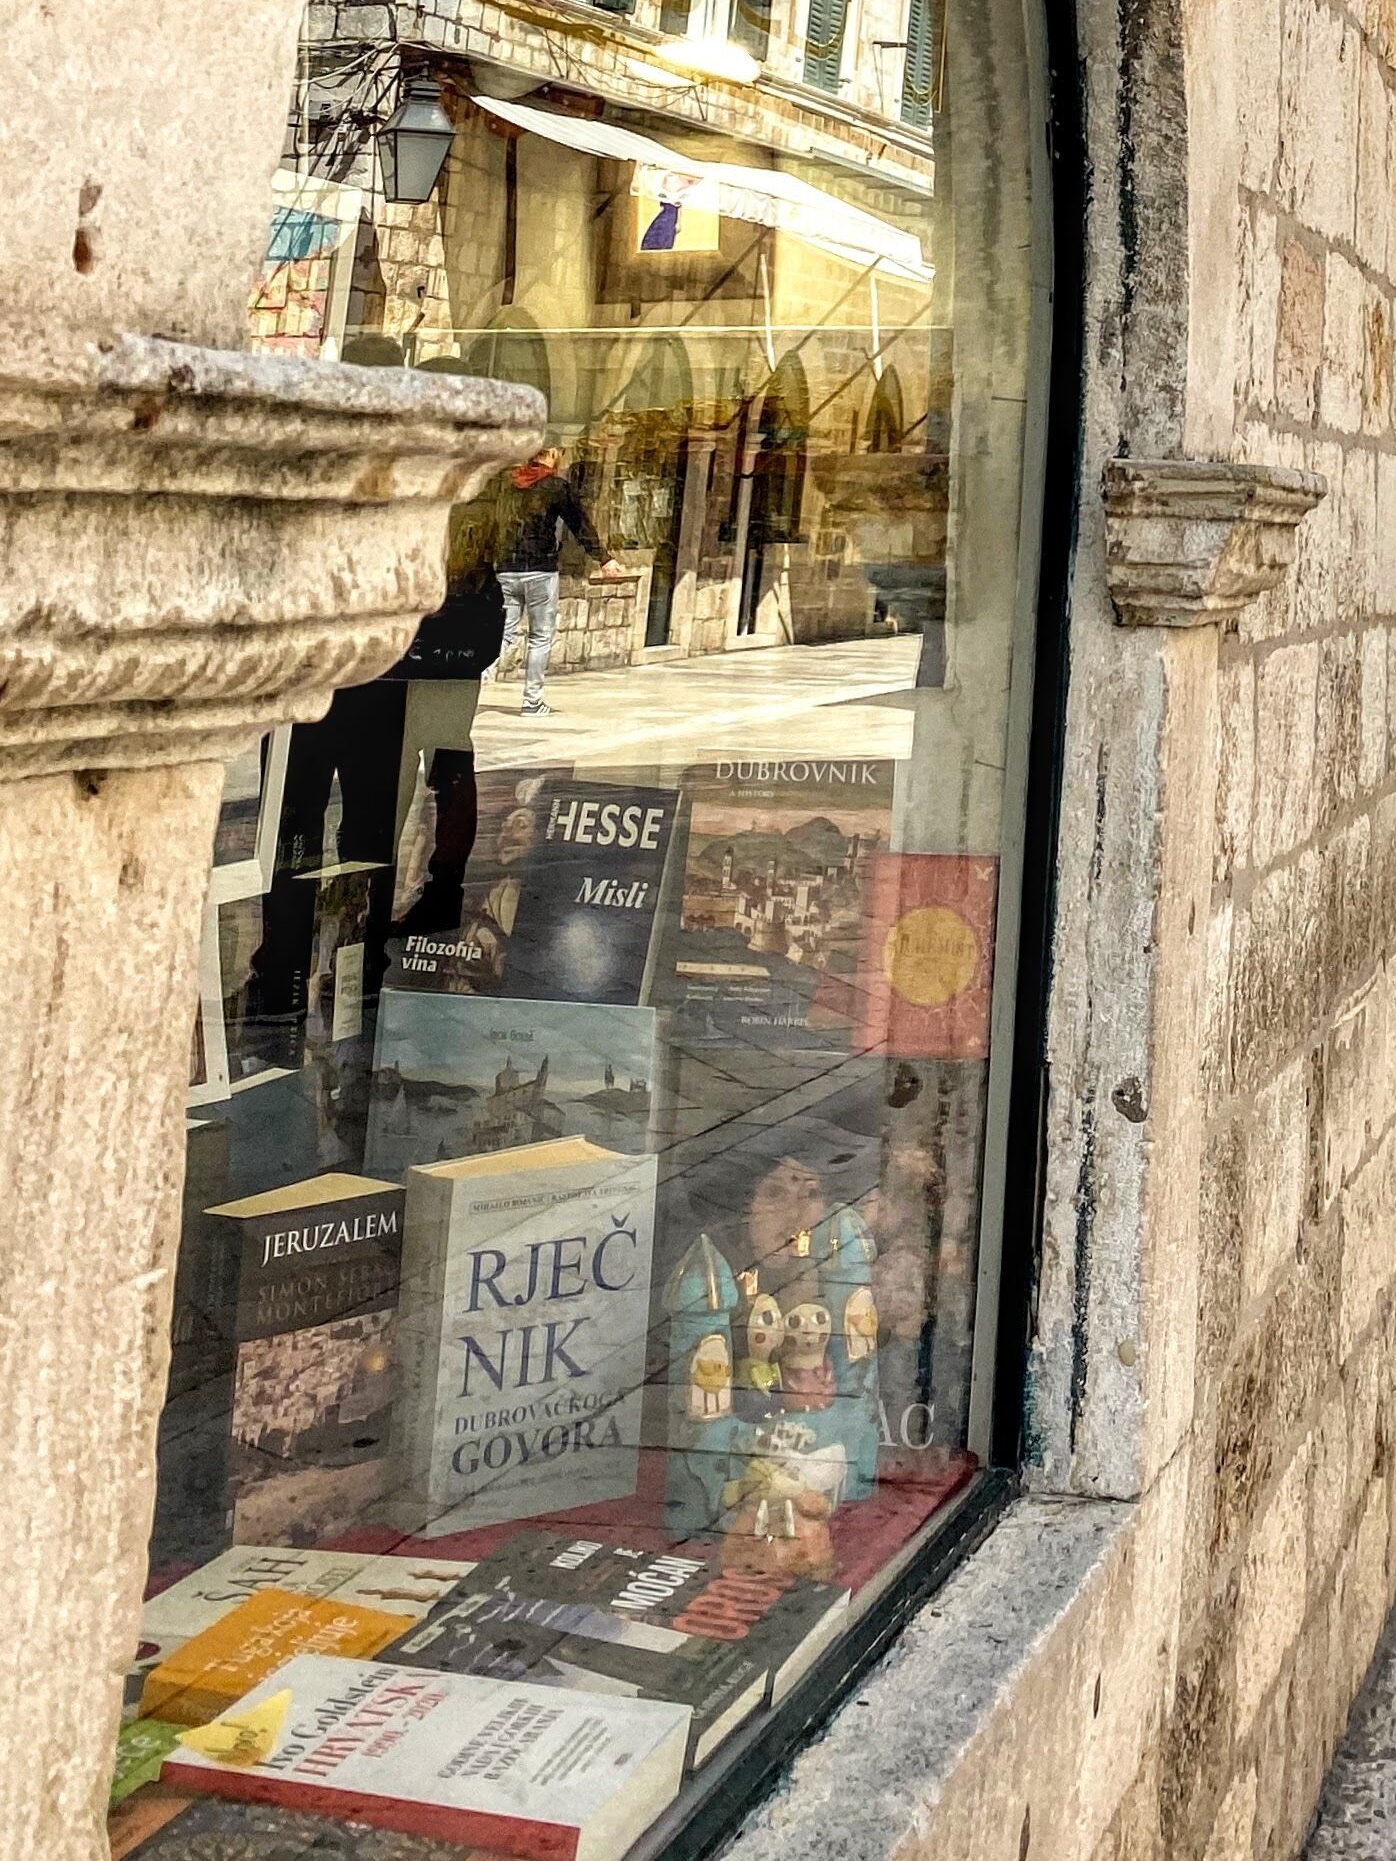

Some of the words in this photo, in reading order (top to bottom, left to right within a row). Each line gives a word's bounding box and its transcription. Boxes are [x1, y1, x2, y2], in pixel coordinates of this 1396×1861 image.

[714, 759, 878, 785] DUBROVNIK
[555, 801, 664, 850] HESSE
[573, 876, 649, 909] Misli
[401, 954, 438, 973] vina
[404, 935, 483, 960] Filozofija
[260, 1210, 398, 1268] JERUZALEM
[462, 1212, 638, 1314] RJEČ
[456, 1316, 593, 1399] NIK
[451, 1415, 624, 1476] GOVORA
[610, 1555, 707, 1611] MOĆAN
[252, 1743, 306, 1770] Ivo
[290, 1668, 399, 1739] Goldstein
